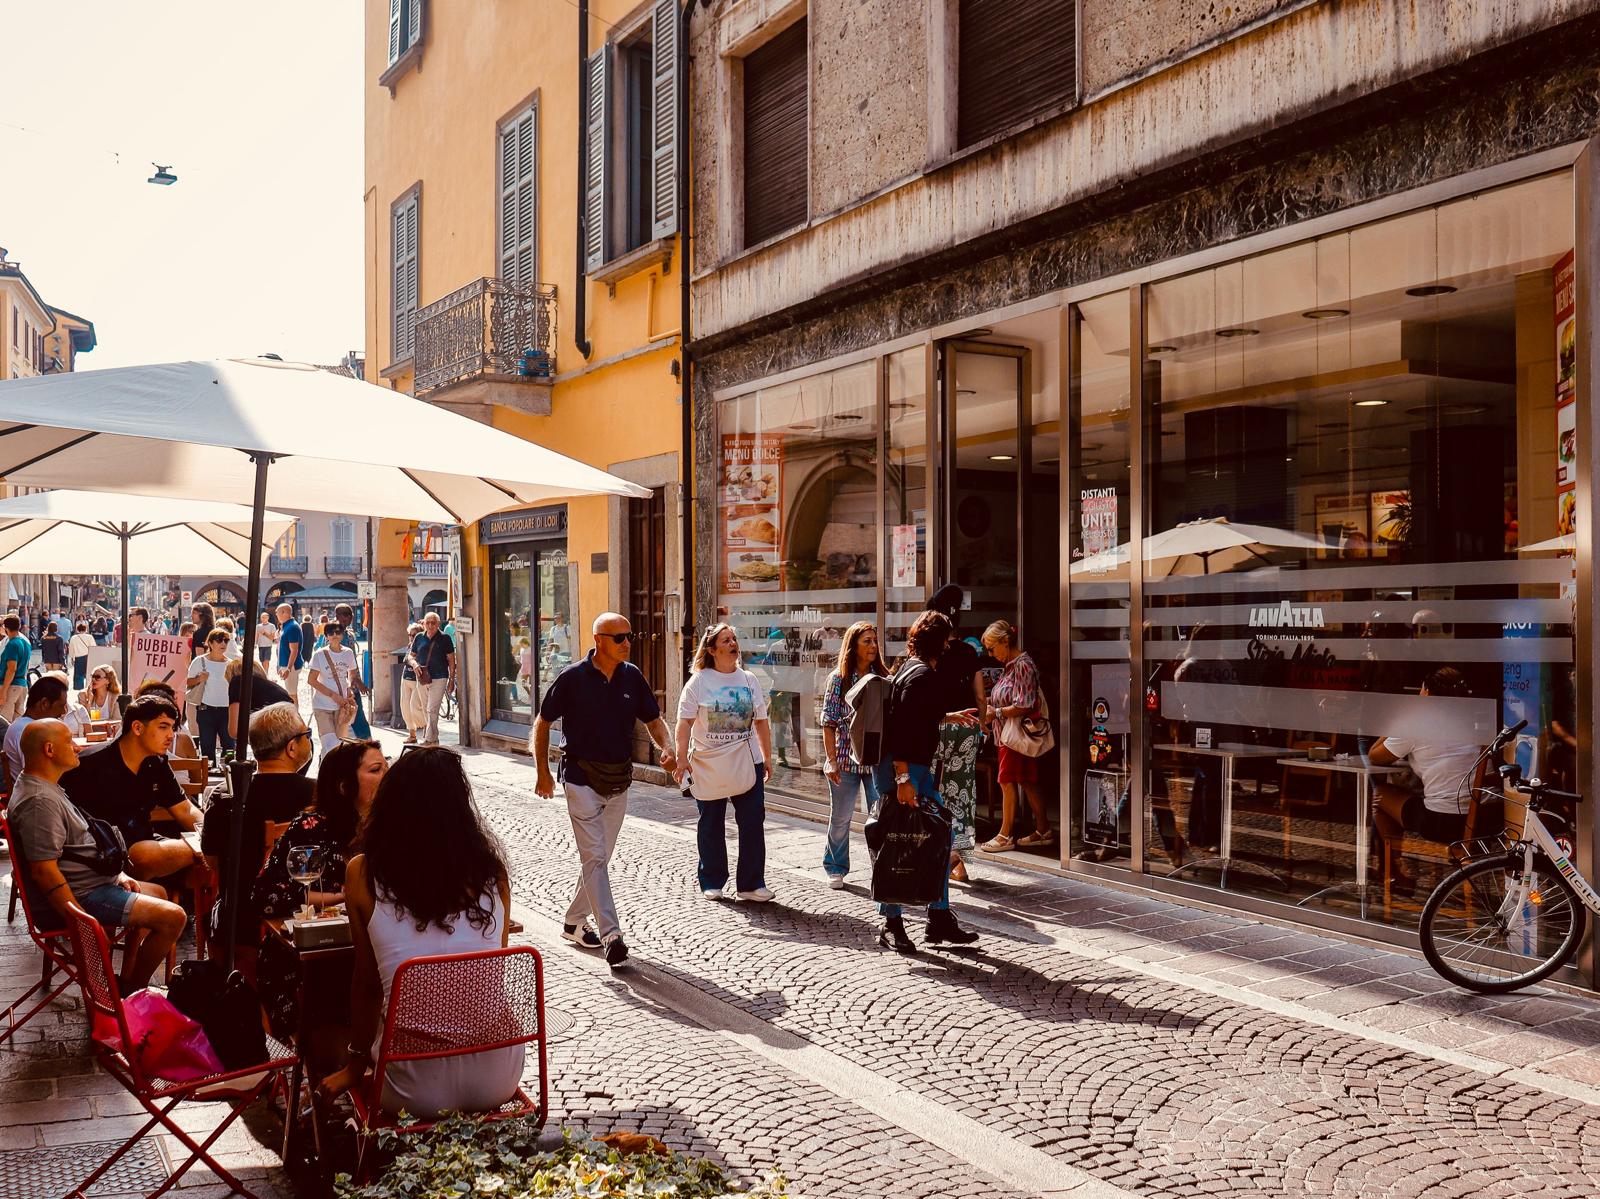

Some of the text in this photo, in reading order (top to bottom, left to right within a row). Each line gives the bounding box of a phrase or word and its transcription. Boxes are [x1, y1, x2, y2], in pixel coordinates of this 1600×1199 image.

[1081, 487, 1116, 500] DISTANTI
[490, 514, 558, 534] BANCA POPOLARE DI LODI
[1081, 512, 1116, 528] UNITI
[1248, 600, 1325, 628] LAVAZZA
[137, 638, 183, 654] BUBBLE
[145, 653, 167, 668] TEA
